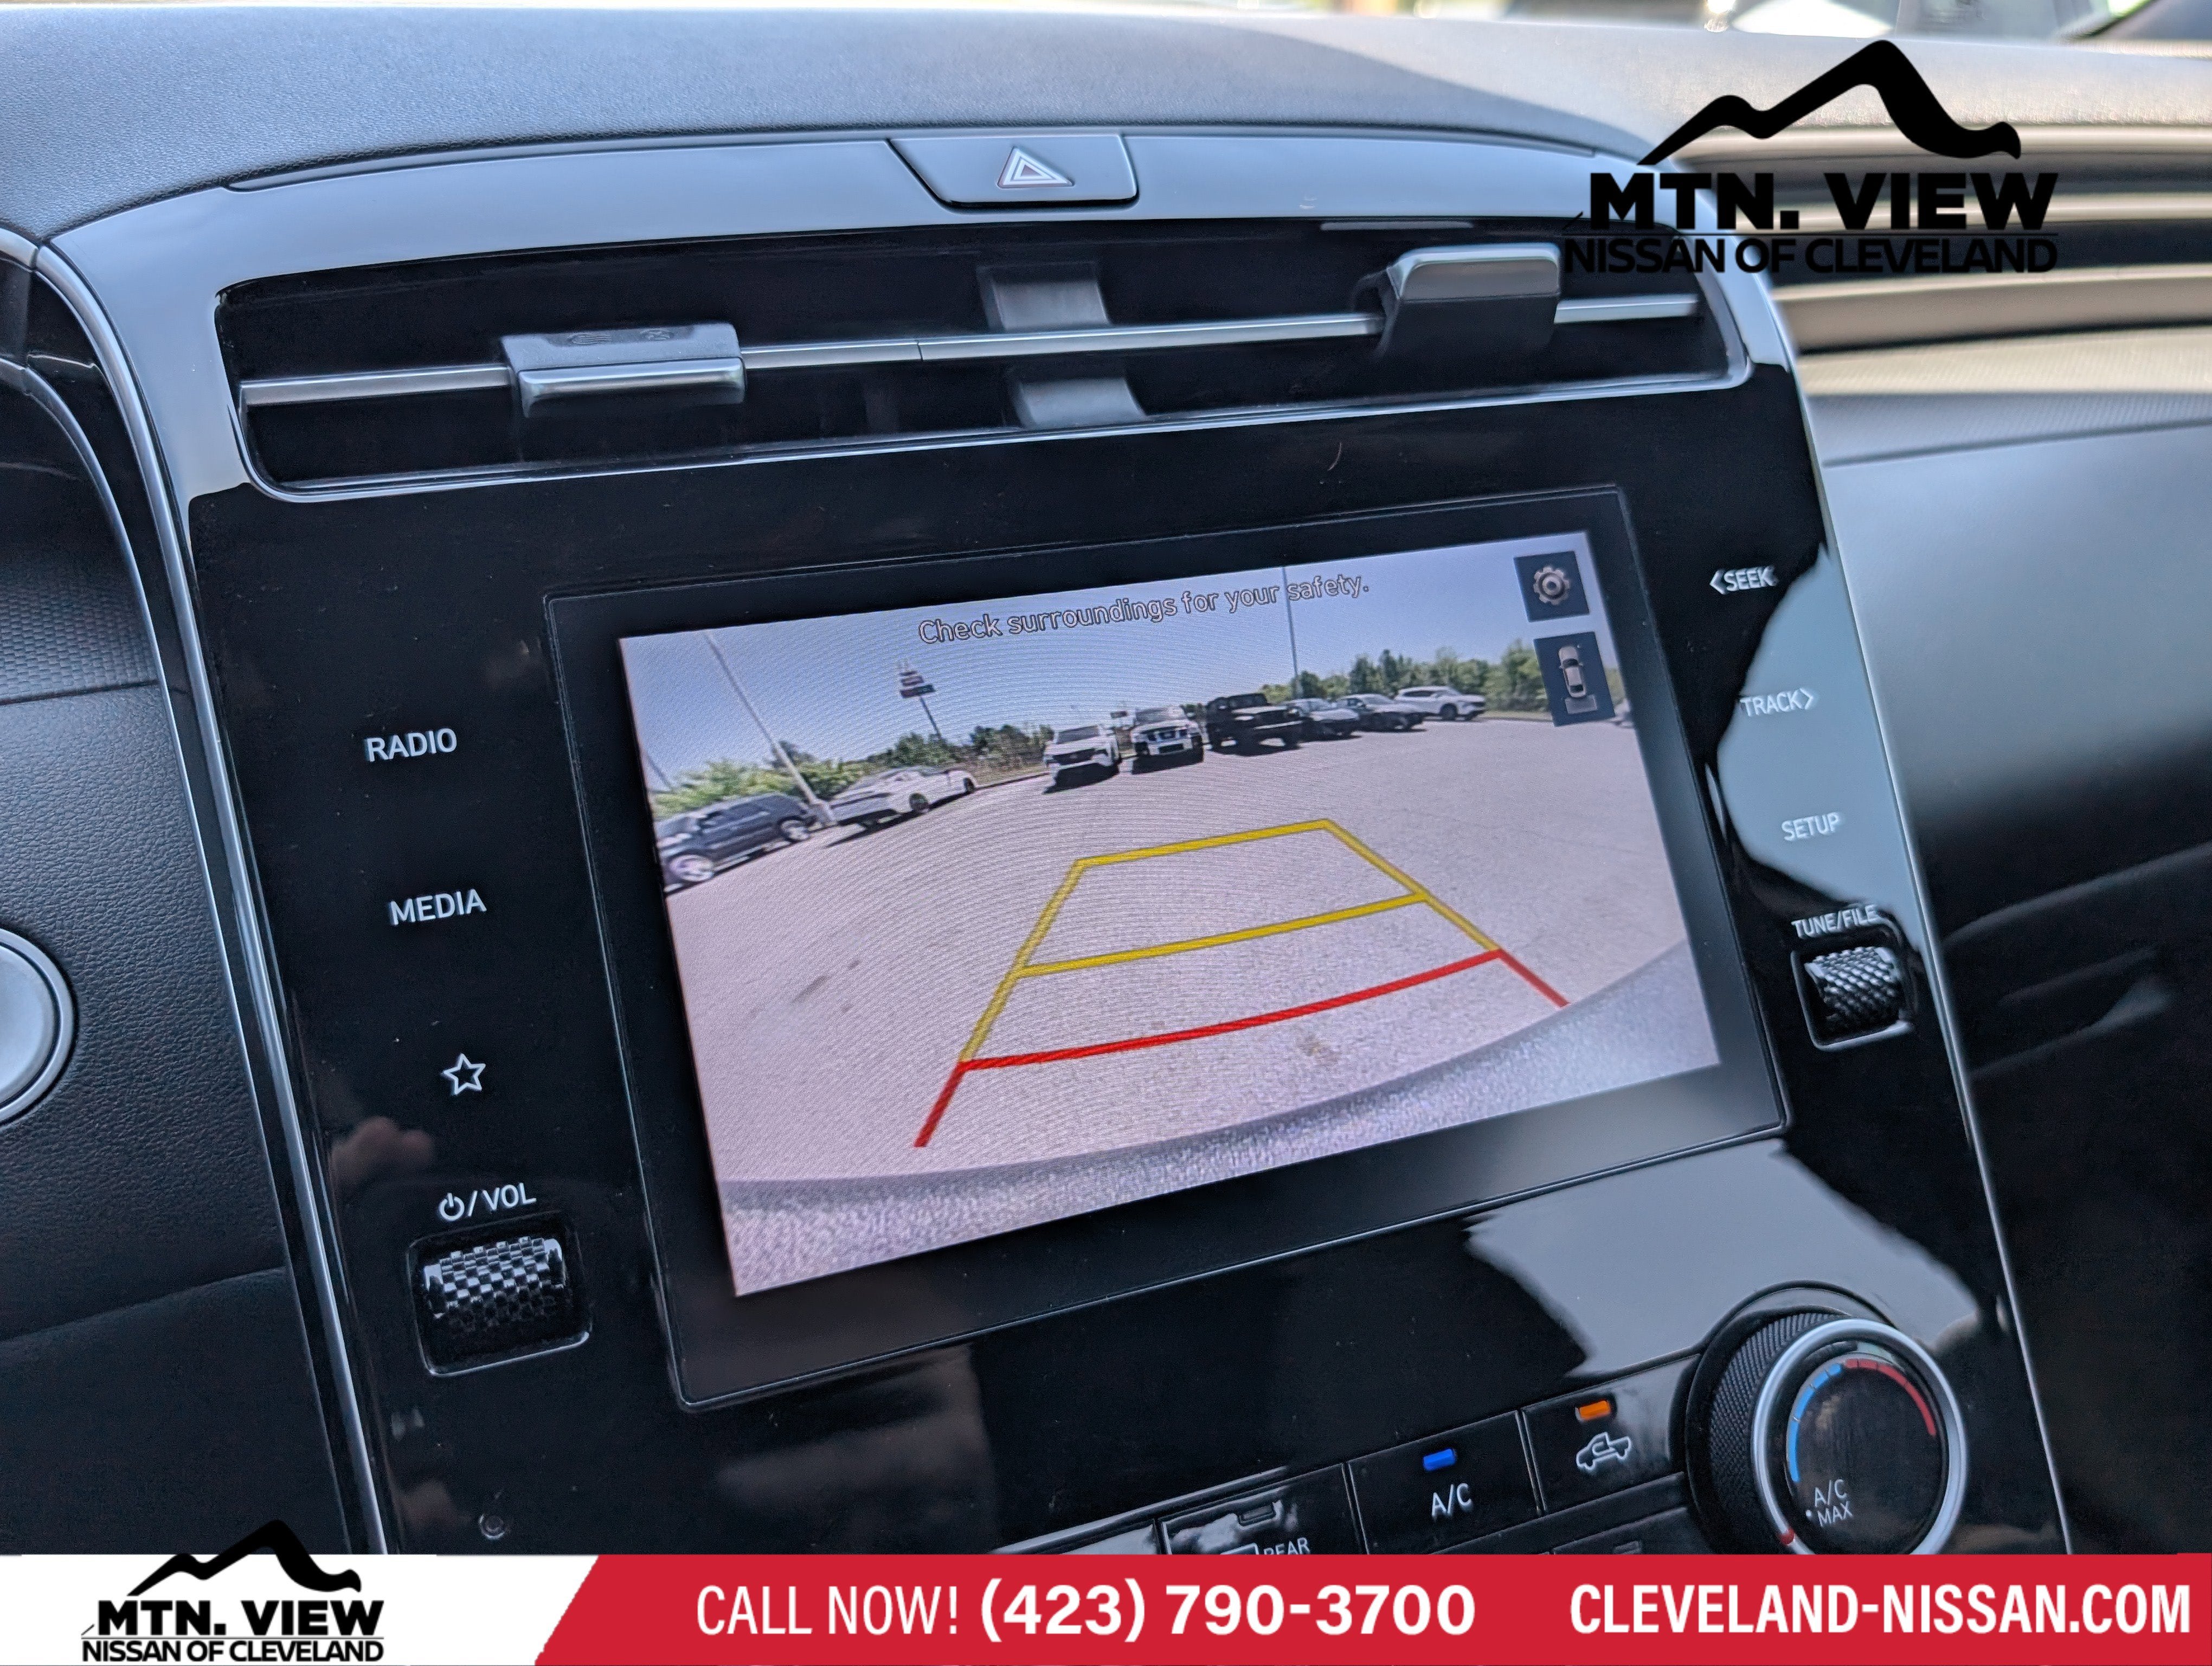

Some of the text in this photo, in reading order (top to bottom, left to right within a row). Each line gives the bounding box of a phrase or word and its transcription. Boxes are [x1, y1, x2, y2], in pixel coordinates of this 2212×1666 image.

[1724, 566, 1778, 592] SEEK
[918, 574, 1369, 644] Check surroundings for your safety.
[1739, 688, 1803, 717] TRACK
[364, 728, 458, 762] RADIO
[1782, 812, 1841, 841] SETUP
[388, 888, 487, 926] MEDIA
[1791, 904, 1880, 939] TUNE/FILE
[1432, 1483, 1472, 1518] A/C
[1814, 1479, 1848, 1508] A/C
[1817, 1501, 1853, 1528] MAX
